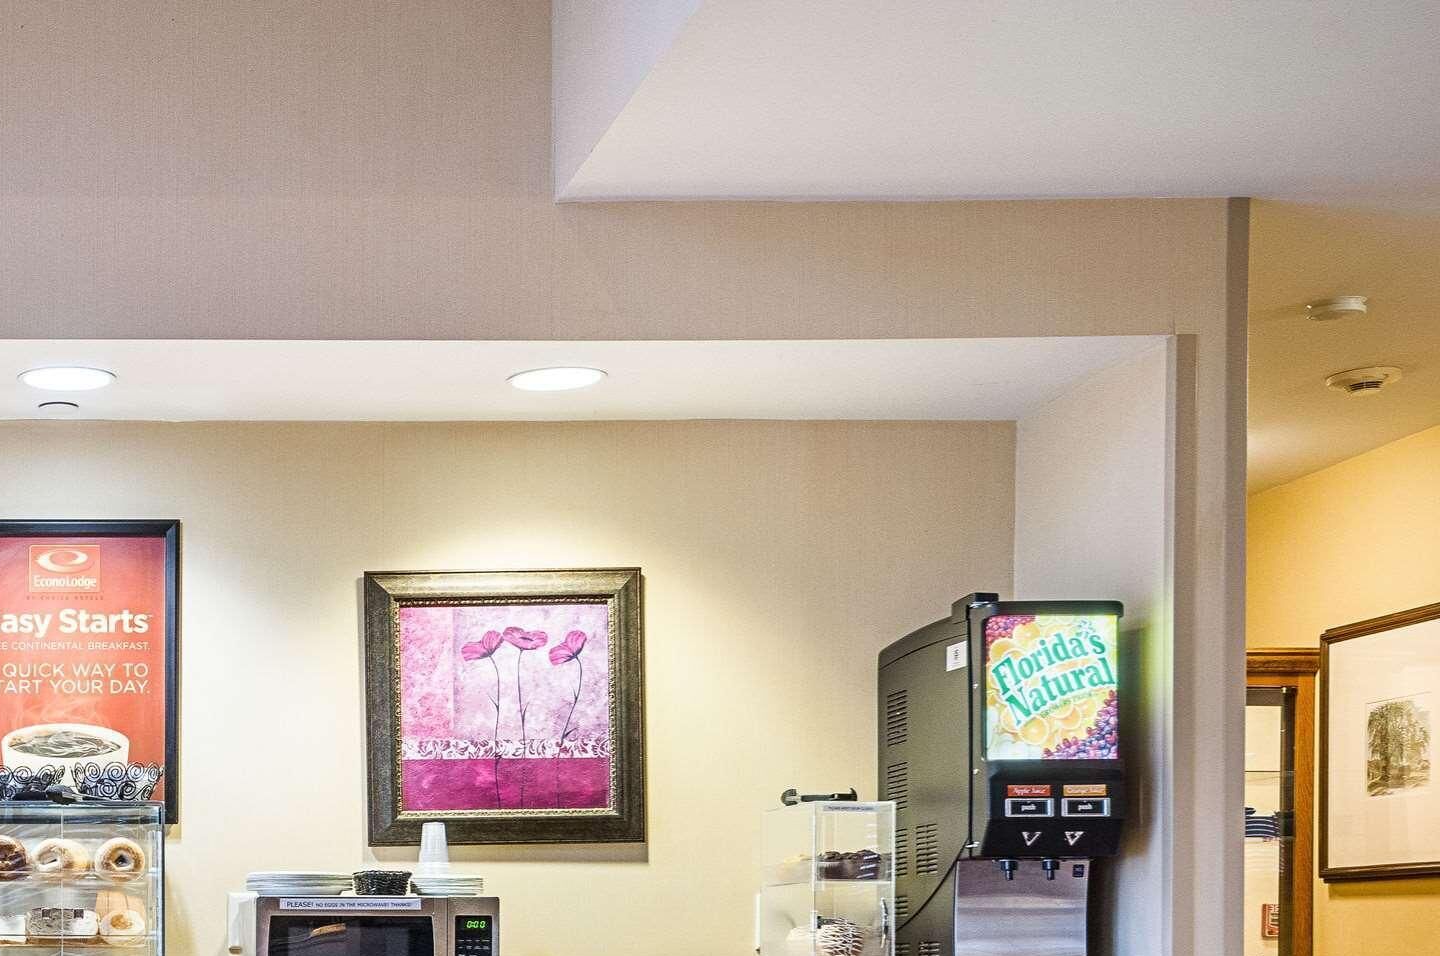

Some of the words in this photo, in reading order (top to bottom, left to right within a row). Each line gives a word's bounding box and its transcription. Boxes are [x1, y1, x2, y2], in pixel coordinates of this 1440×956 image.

[59, 608, 149, 634] Starts
[12, 641, 84, 650] CONTINENTAL
[87, 641, 151, 650] BREAKFAST.
[2, 663, 65, 678] QUICK
[72, 663, 115, 677] WAY
[123, 663, 149, 678] TO
[991, 632, 1106, 695] Florida's
[50, 680, 103, 694] YOUR
[110, 680, 150, 694] DAY.
[1005, 657, 1116, 726] Natural
[1021, 804, 1037, 812] push
[1078, 803, 1093, 811] push
[466, 920, 485, 928] 0:00
